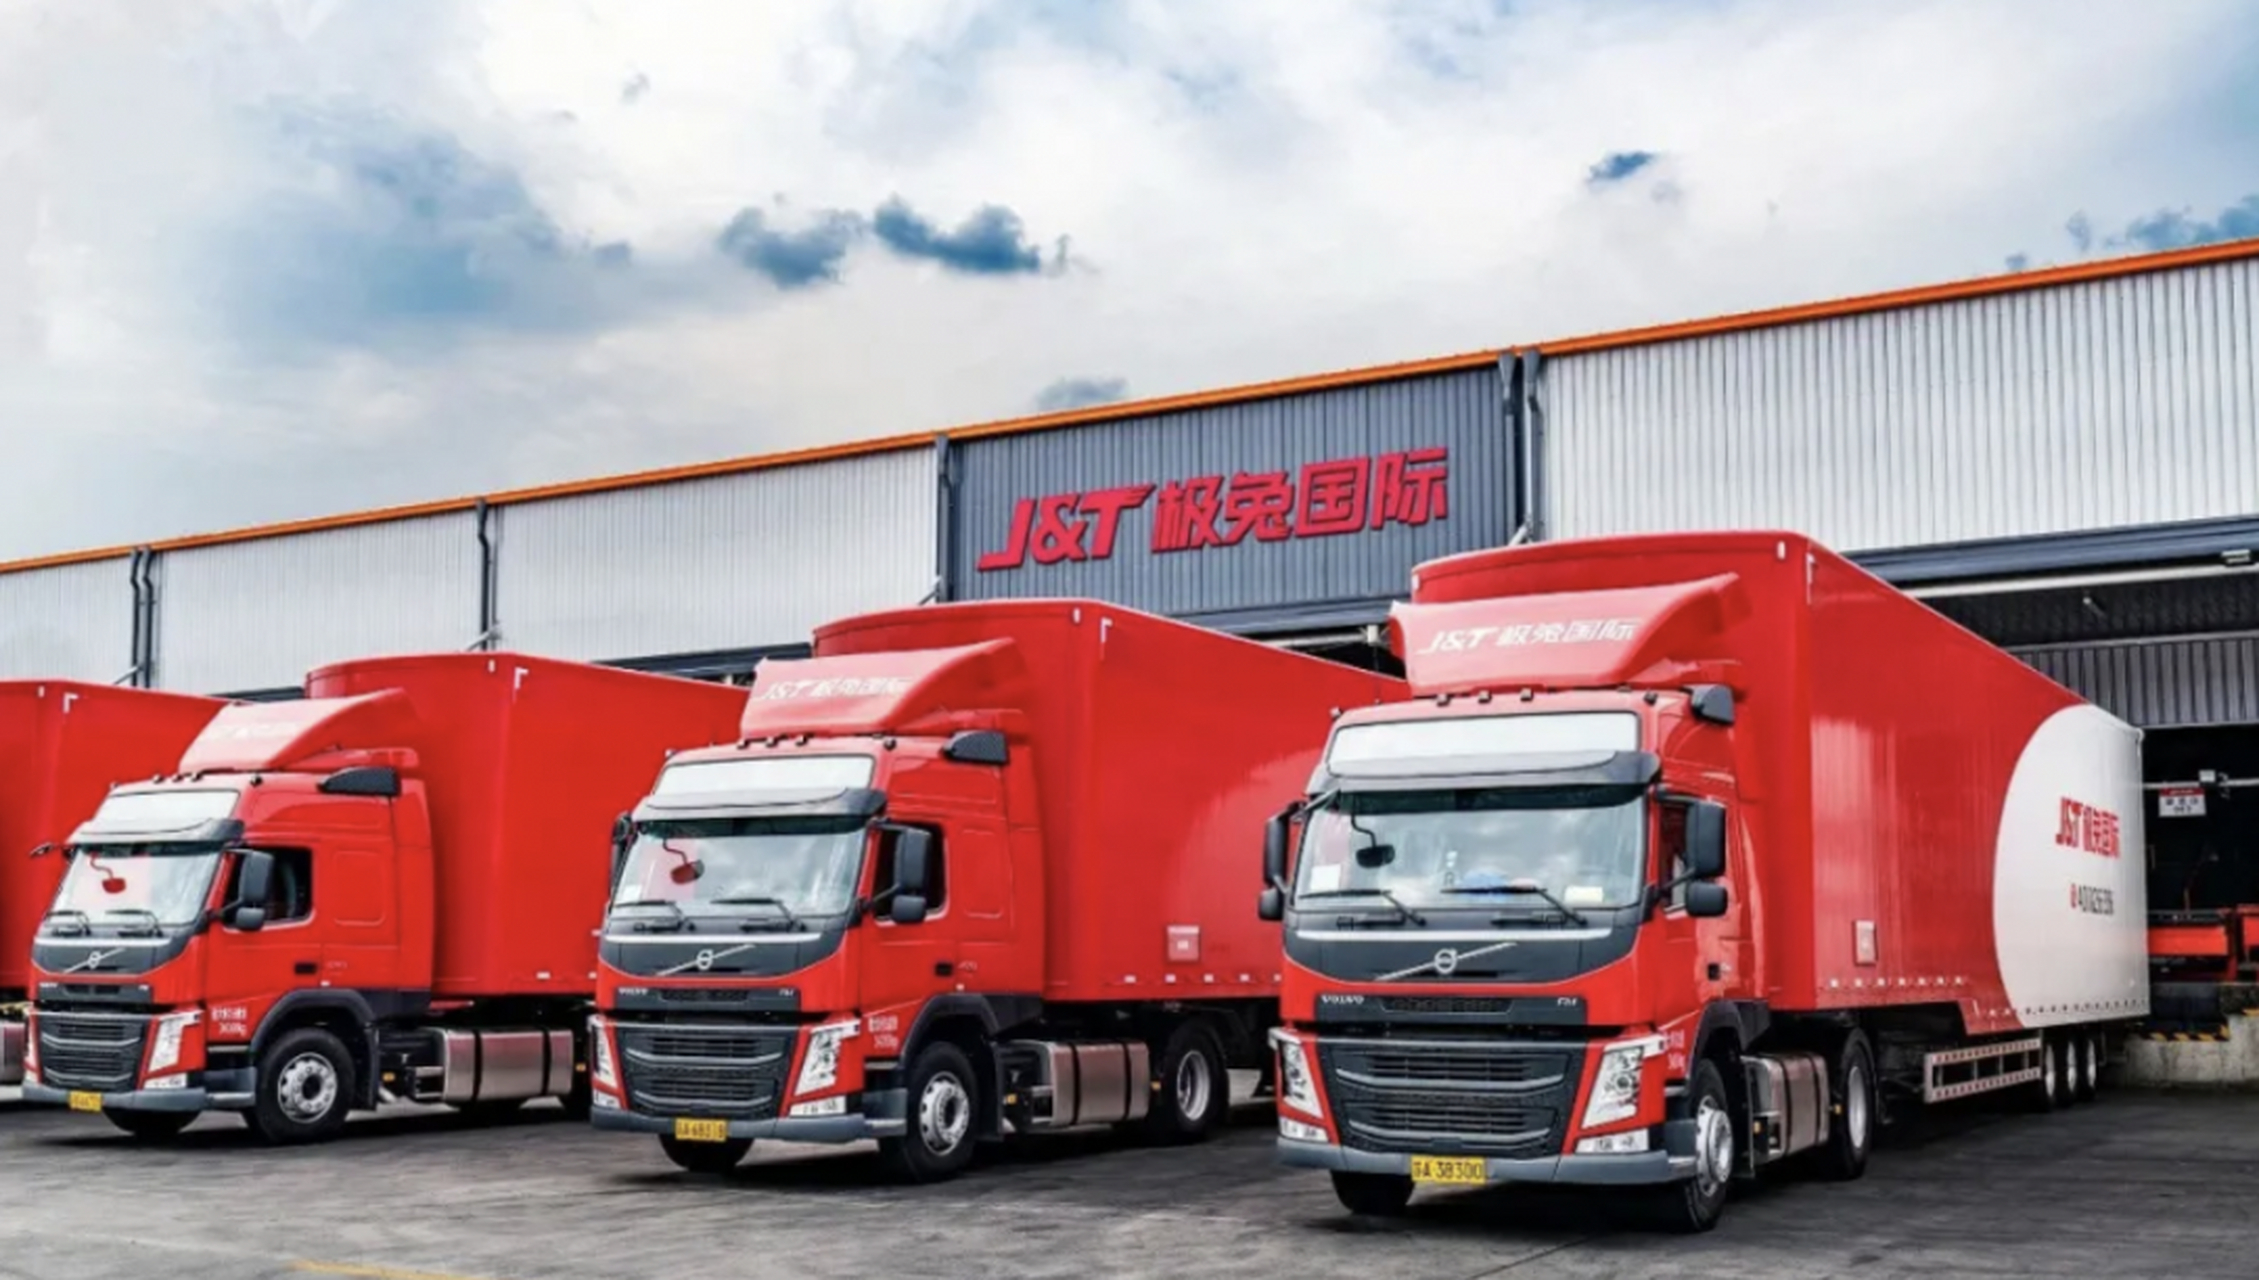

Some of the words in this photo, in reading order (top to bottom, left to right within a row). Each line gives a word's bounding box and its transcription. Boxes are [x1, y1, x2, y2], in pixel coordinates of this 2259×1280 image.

[976, 483, 1156, 571] J&T
[1151, 447, 1447, 554] 极兔国际
[1417, 626, 1497, 655] J&T
[1497, 617, 1641, 647] 极兔国际
[1321, 994, 1365, 1005] VOLVO
